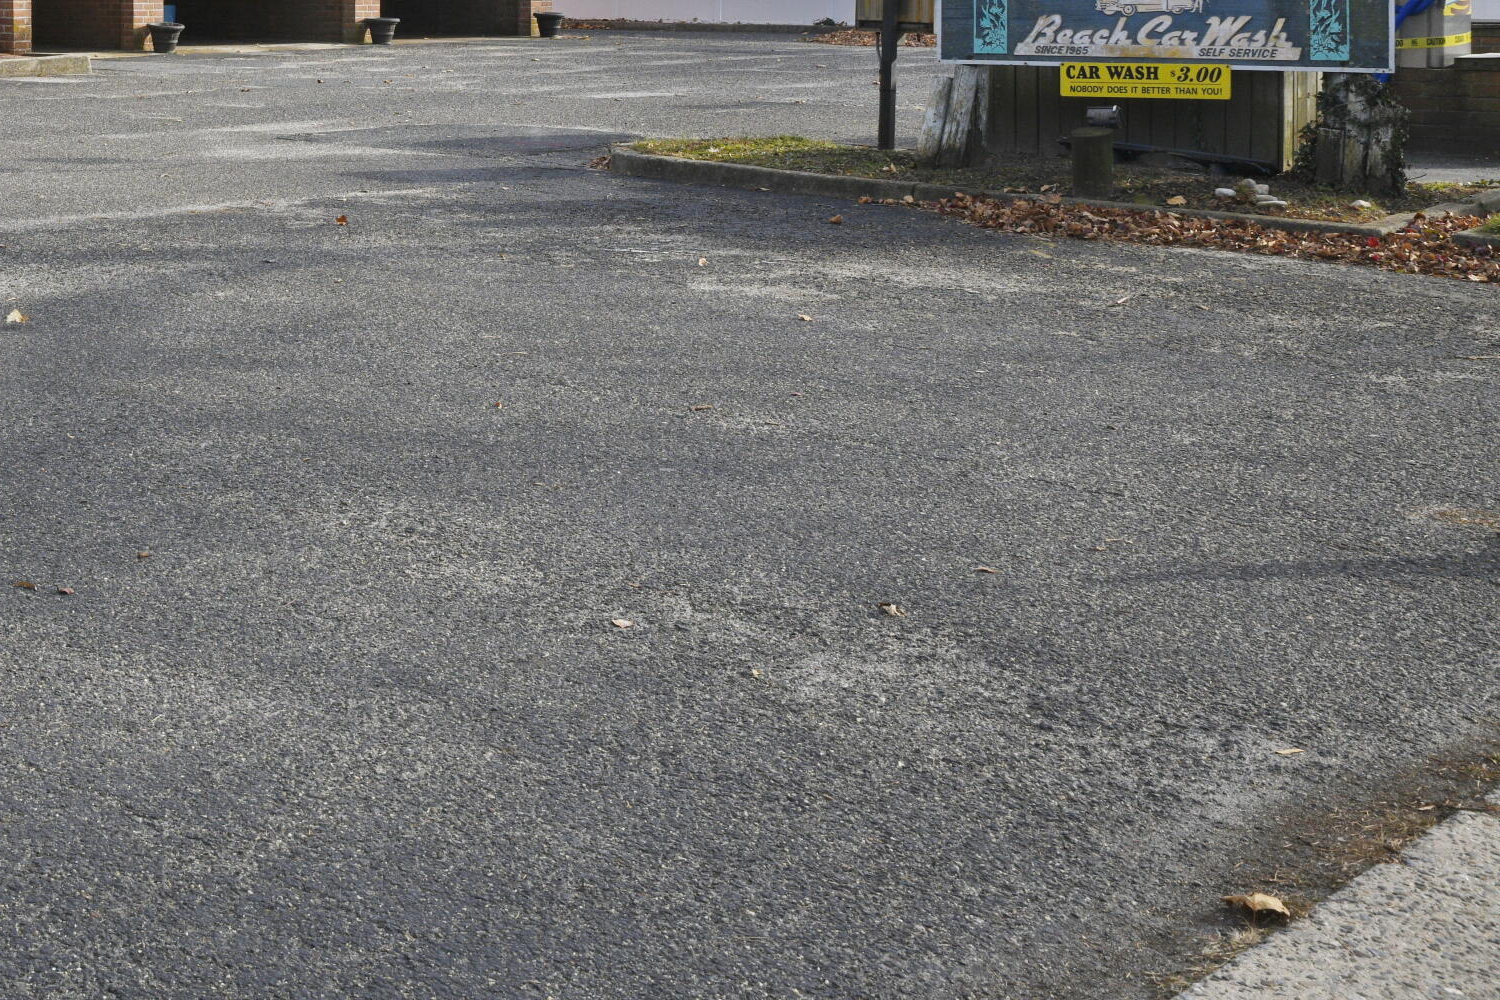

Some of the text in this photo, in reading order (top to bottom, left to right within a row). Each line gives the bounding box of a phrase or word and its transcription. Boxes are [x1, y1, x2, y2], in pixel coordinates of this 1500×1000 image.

[1022, 14, 1293, 48] Beach Car Wash
[1034, 46, 1089, 55] SINCE 1965
[1198, 48, 1278, 58] SELF SERVICE
[1066, 65, 1222, 82] CAR WASH $3.00
[1070, 85, 1223, 96] NOBODY DOES IT BETTER THAN YOU!
